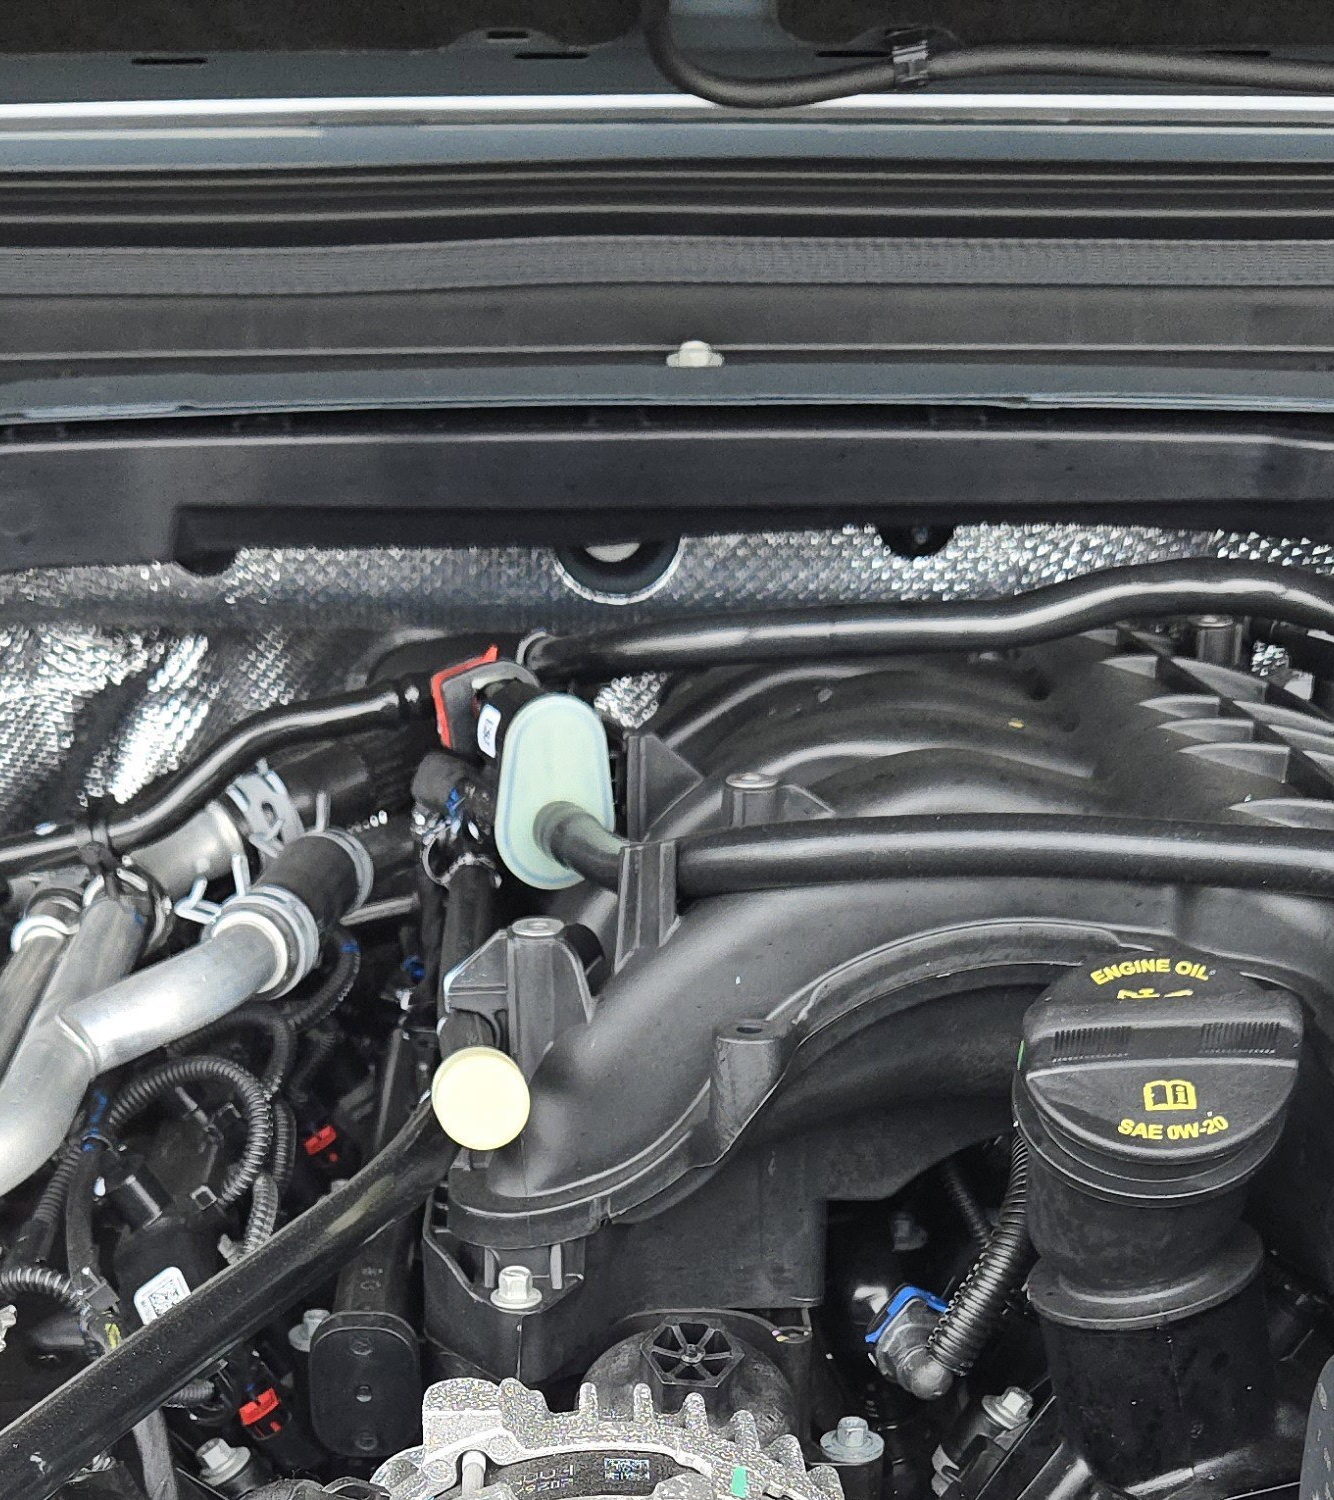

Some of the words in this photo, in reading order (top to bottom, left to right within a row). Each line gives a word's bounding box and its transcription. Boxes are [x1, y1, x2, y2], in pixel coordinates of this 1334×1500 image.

[1090, 958, 1171, 985] ENGINE
[1175, 960, 1209, 981] OIL
[1117, 1118, 1164, 1140] SAE
[1167, 1115, 1229, 1140] 0W-20
